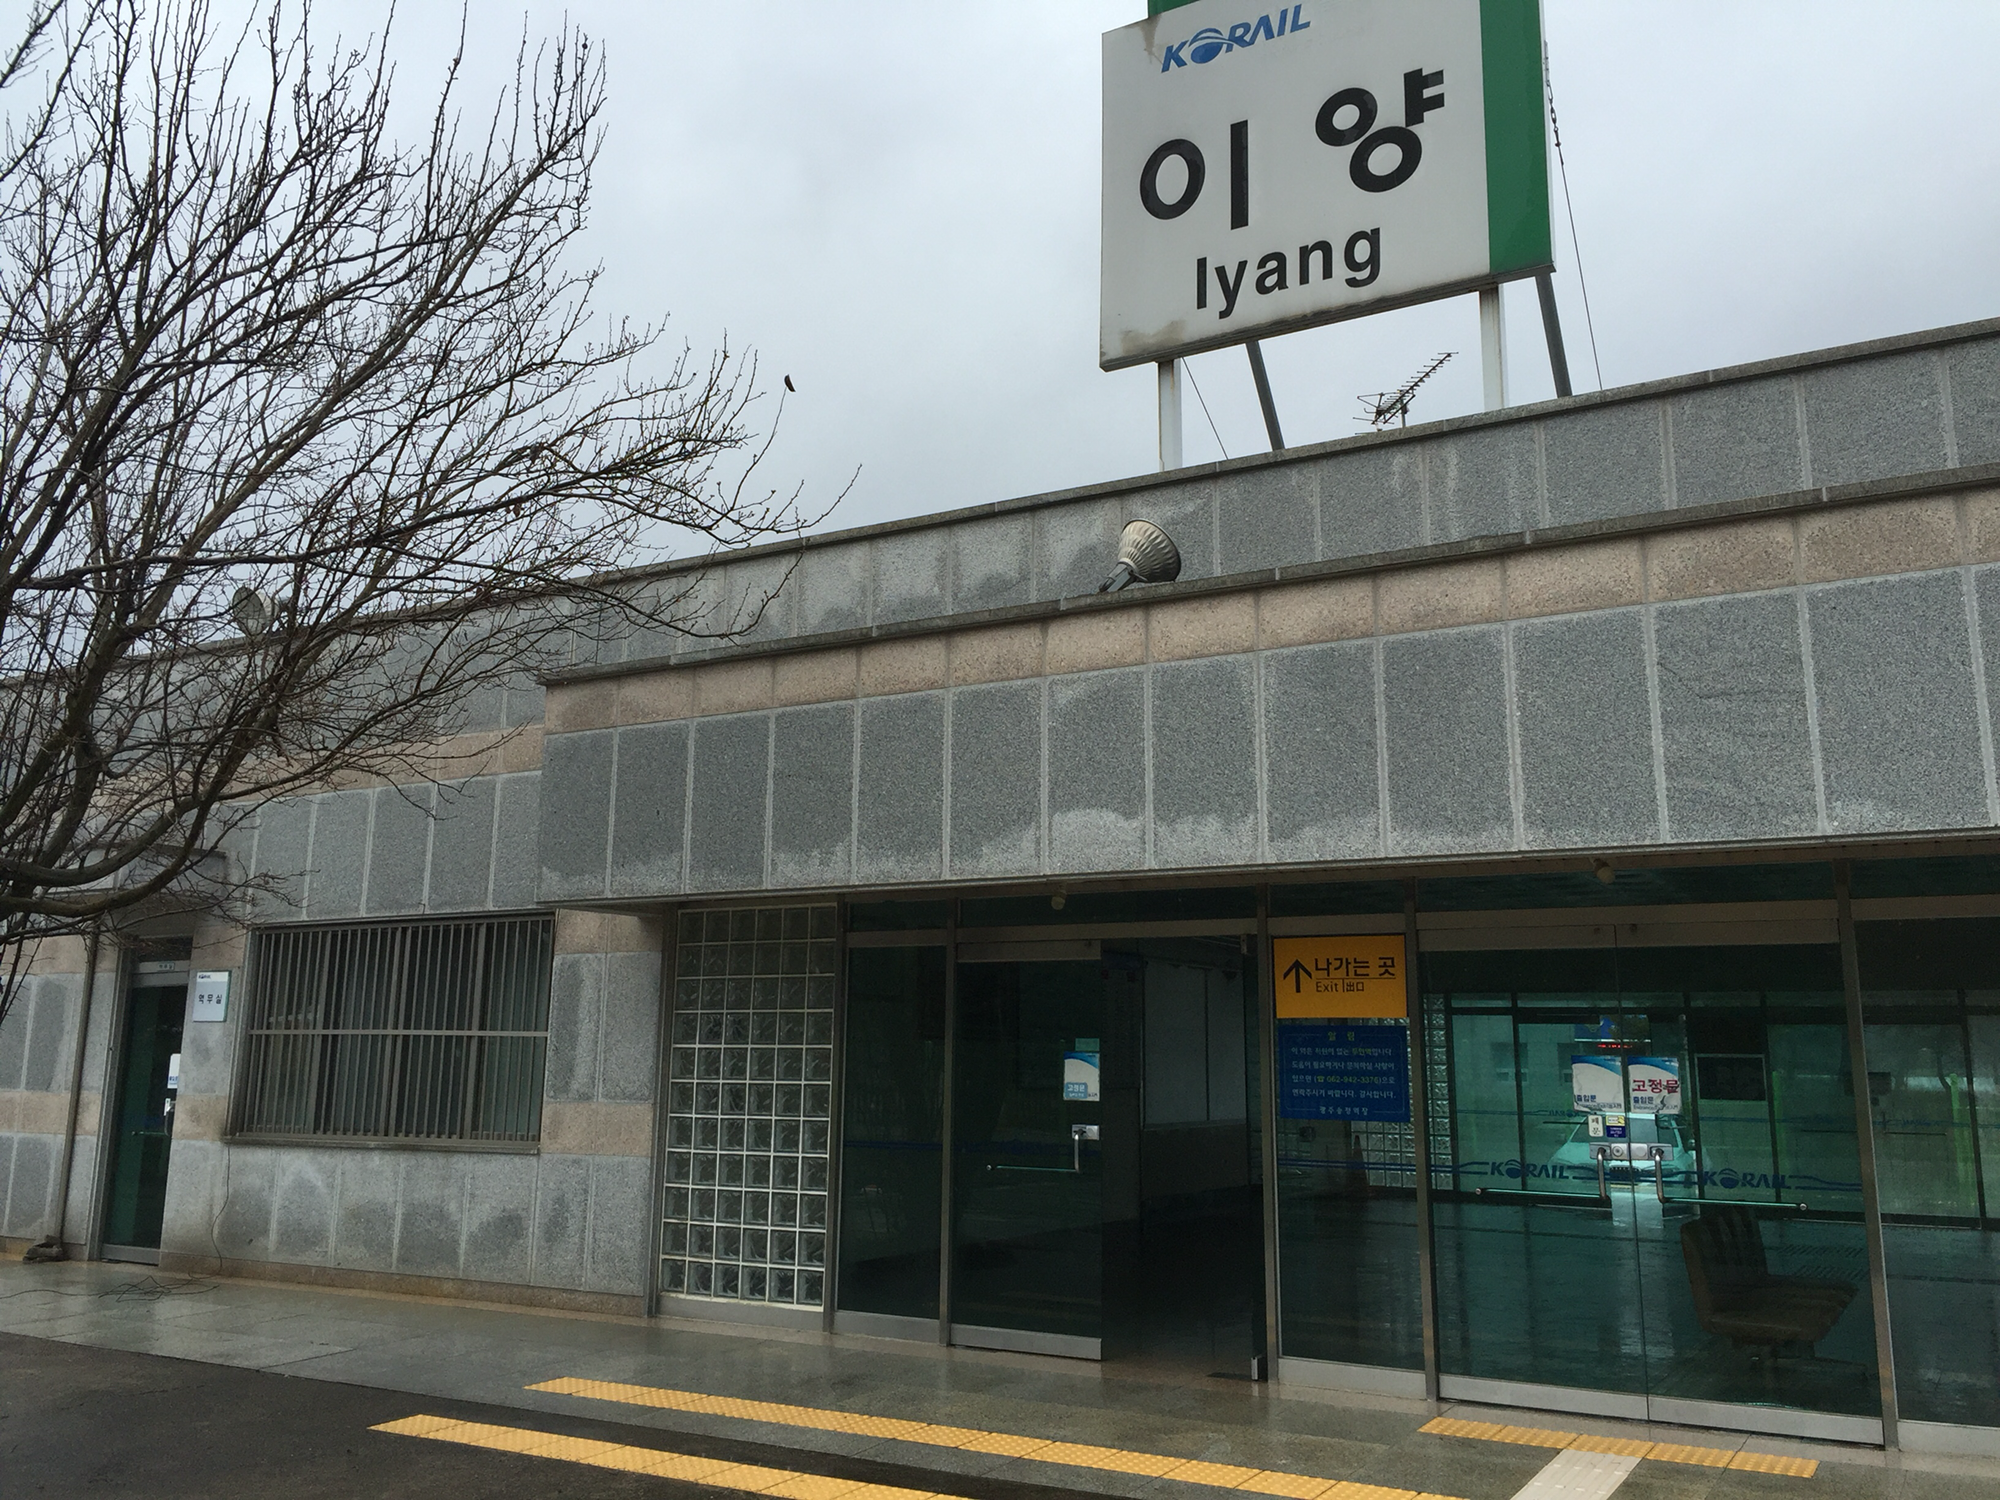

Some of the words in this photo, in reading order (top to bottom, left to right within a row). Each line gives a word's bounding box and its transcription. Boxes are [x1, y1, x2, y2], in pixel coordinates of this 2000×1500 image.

[1161, 4, 1311, 73] KORAIL
[1197, 227, 1381, 320] Iyang
[1314, 957, 1370, 977] 나가는
[1378, 956, 1396, 977] 곳
[1316, 981, 1338, 993] Exit
[1346, 981, 1365, 993] 出口
[198, 994, 222, 1004] 역무실
[1359, 1090, 1397, 1099] 감사합니다.
[1576, 1094, 1597, 1103] 출입문
[1633, 1096, 1654, 1104] 출입문
[1489, 1159, 1569, 1180] KORAIL
[1703, 1168, 1791, 1190] KORAIL
